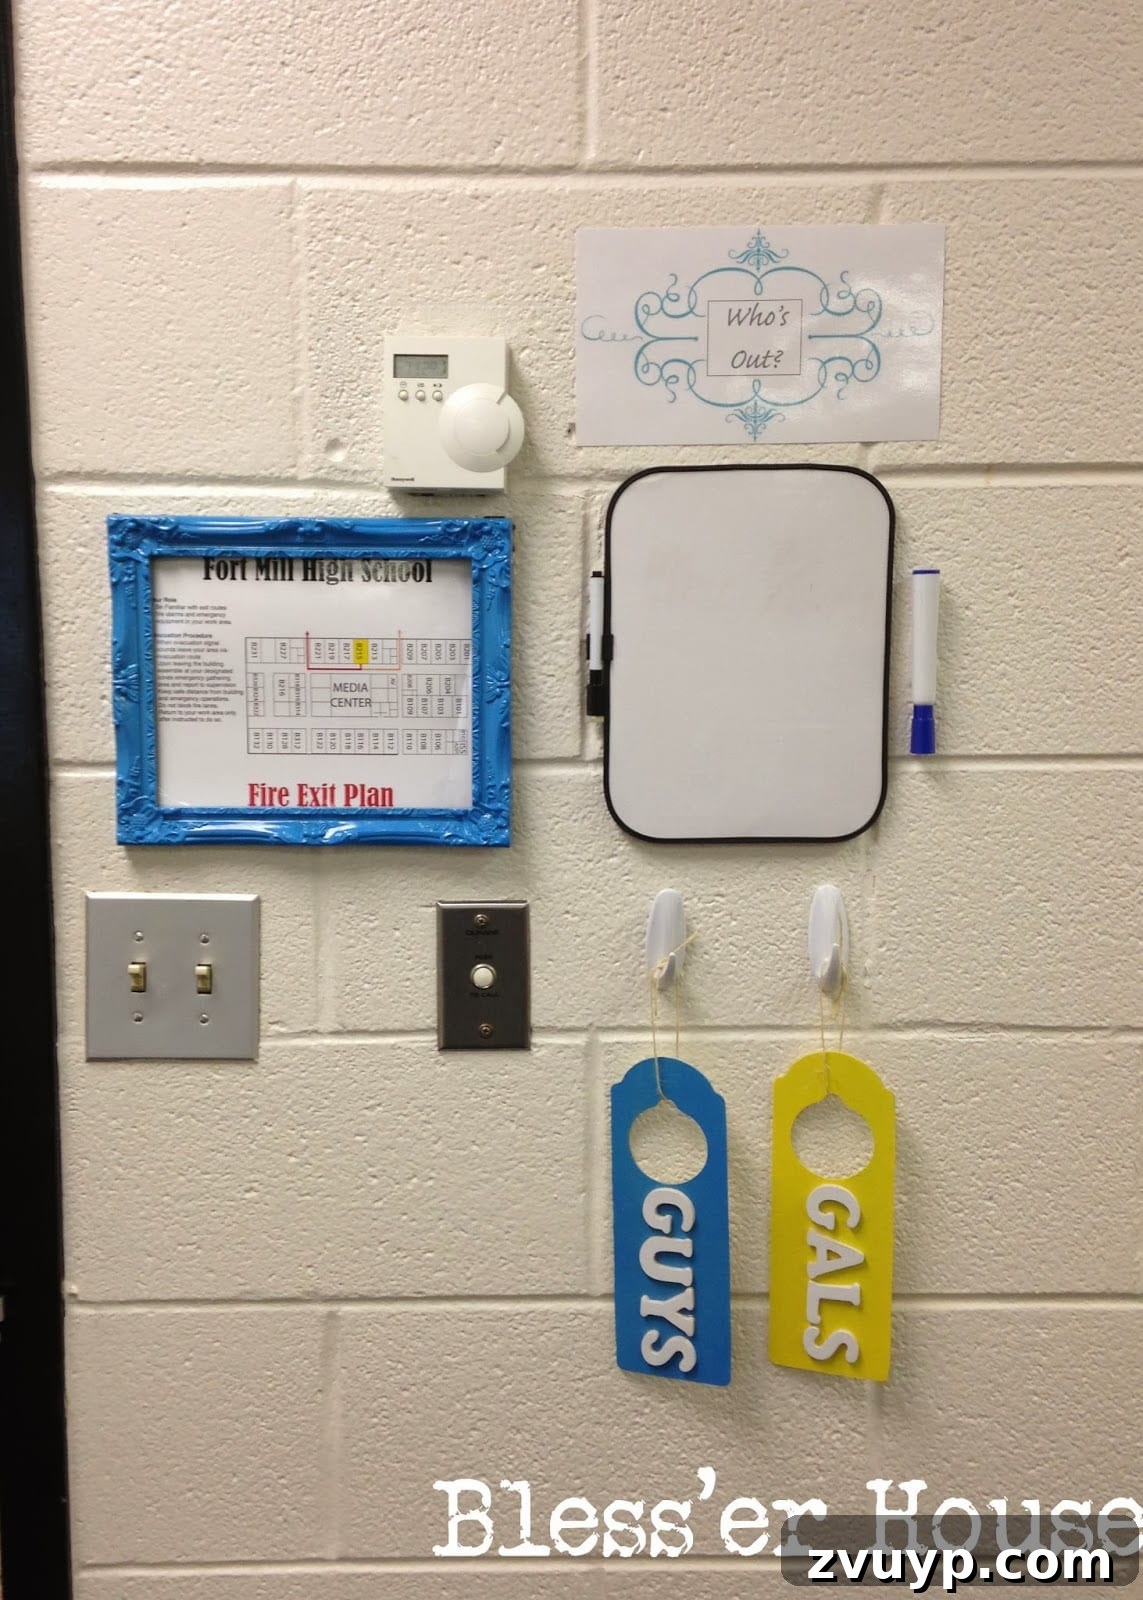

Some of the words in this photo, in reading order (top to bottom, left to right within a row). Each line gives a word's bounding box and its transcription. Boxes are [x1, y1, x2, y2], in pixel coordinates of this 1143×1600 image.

[728, 302, 790, 326] Who's
[731, 350, 784, 368] Out?
[202, 557, 247, 580] Fort
[255, 557, 294, 582] Mill
[302, 557, 354, 585] High
[362, 558, 432, 582] School
[332, 682, 368, 692] MEDIA
[330, 698, 372, 708] CENTER
[248, 784, 290, 807] Fire
[297, 784, 336, 807] Exit
[344, 784, 394, 807] Plan
[639, 1187, 696, 1373] GUYS
[803, 1184, 864, 1365] GALS
